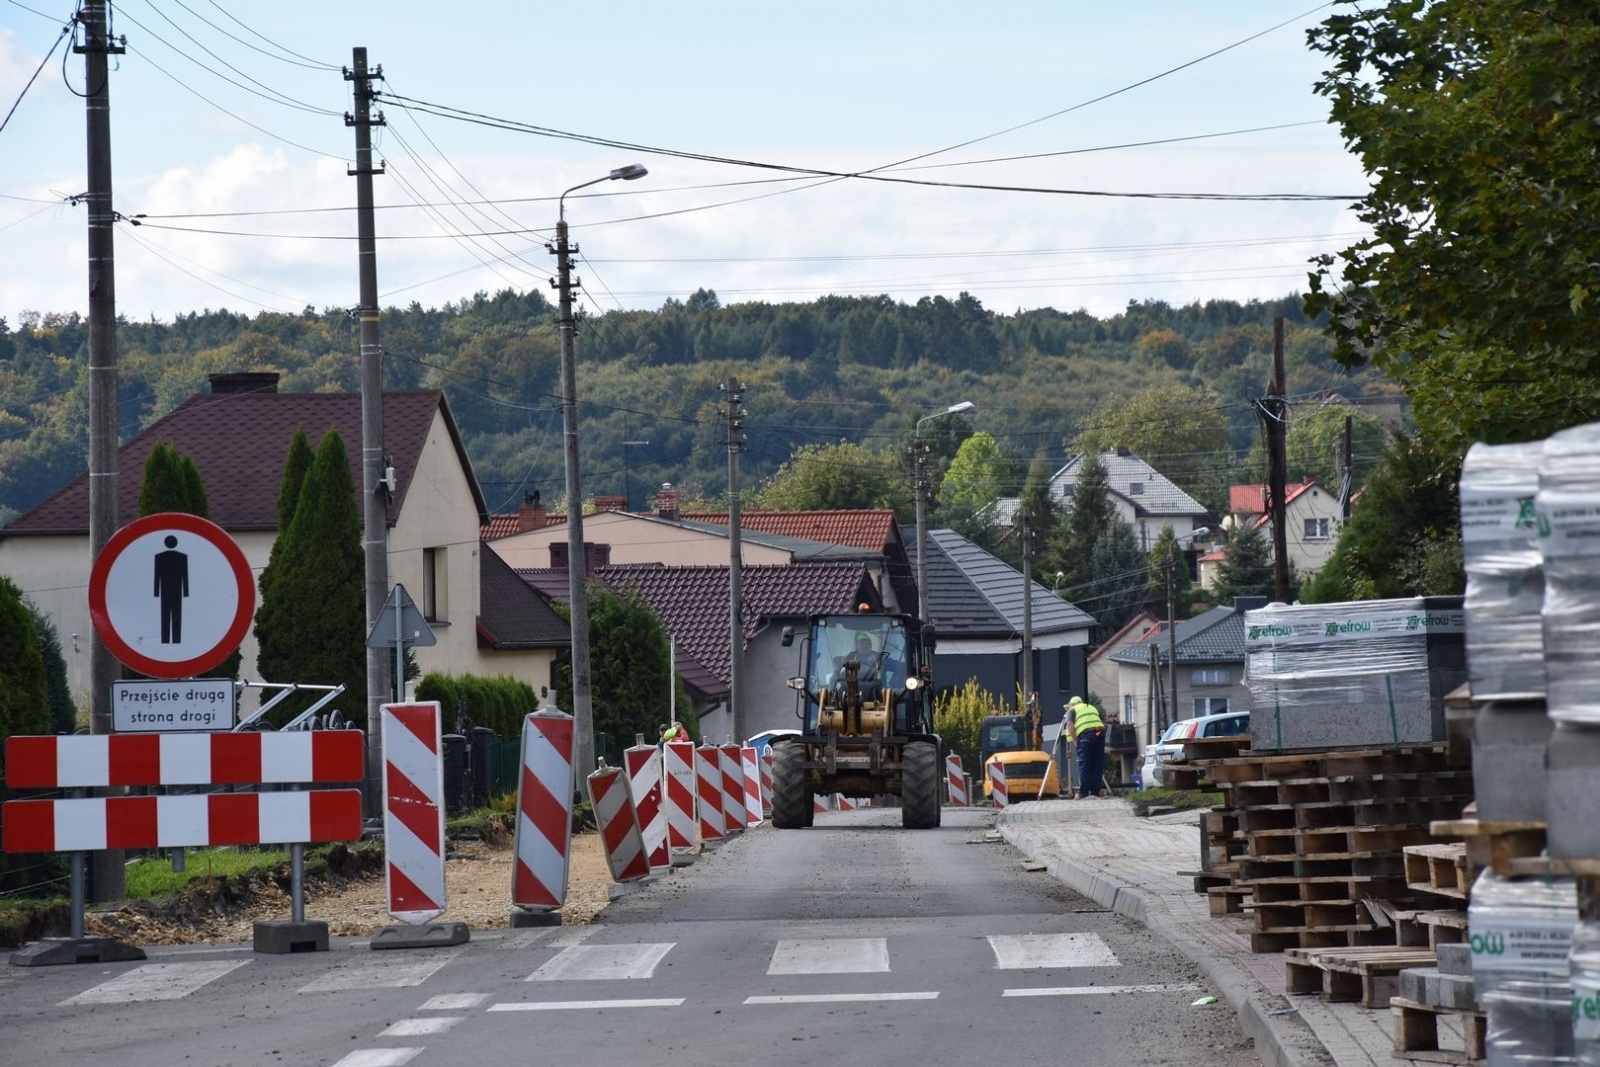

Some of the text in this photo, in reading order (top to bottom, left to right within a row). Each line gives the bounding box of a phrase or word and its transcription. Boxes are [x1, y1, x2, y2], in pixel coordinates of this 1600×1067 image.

[120, 688, 226, 704] Przejście drugą
[130, 709, 216, 725] stroną drogi
